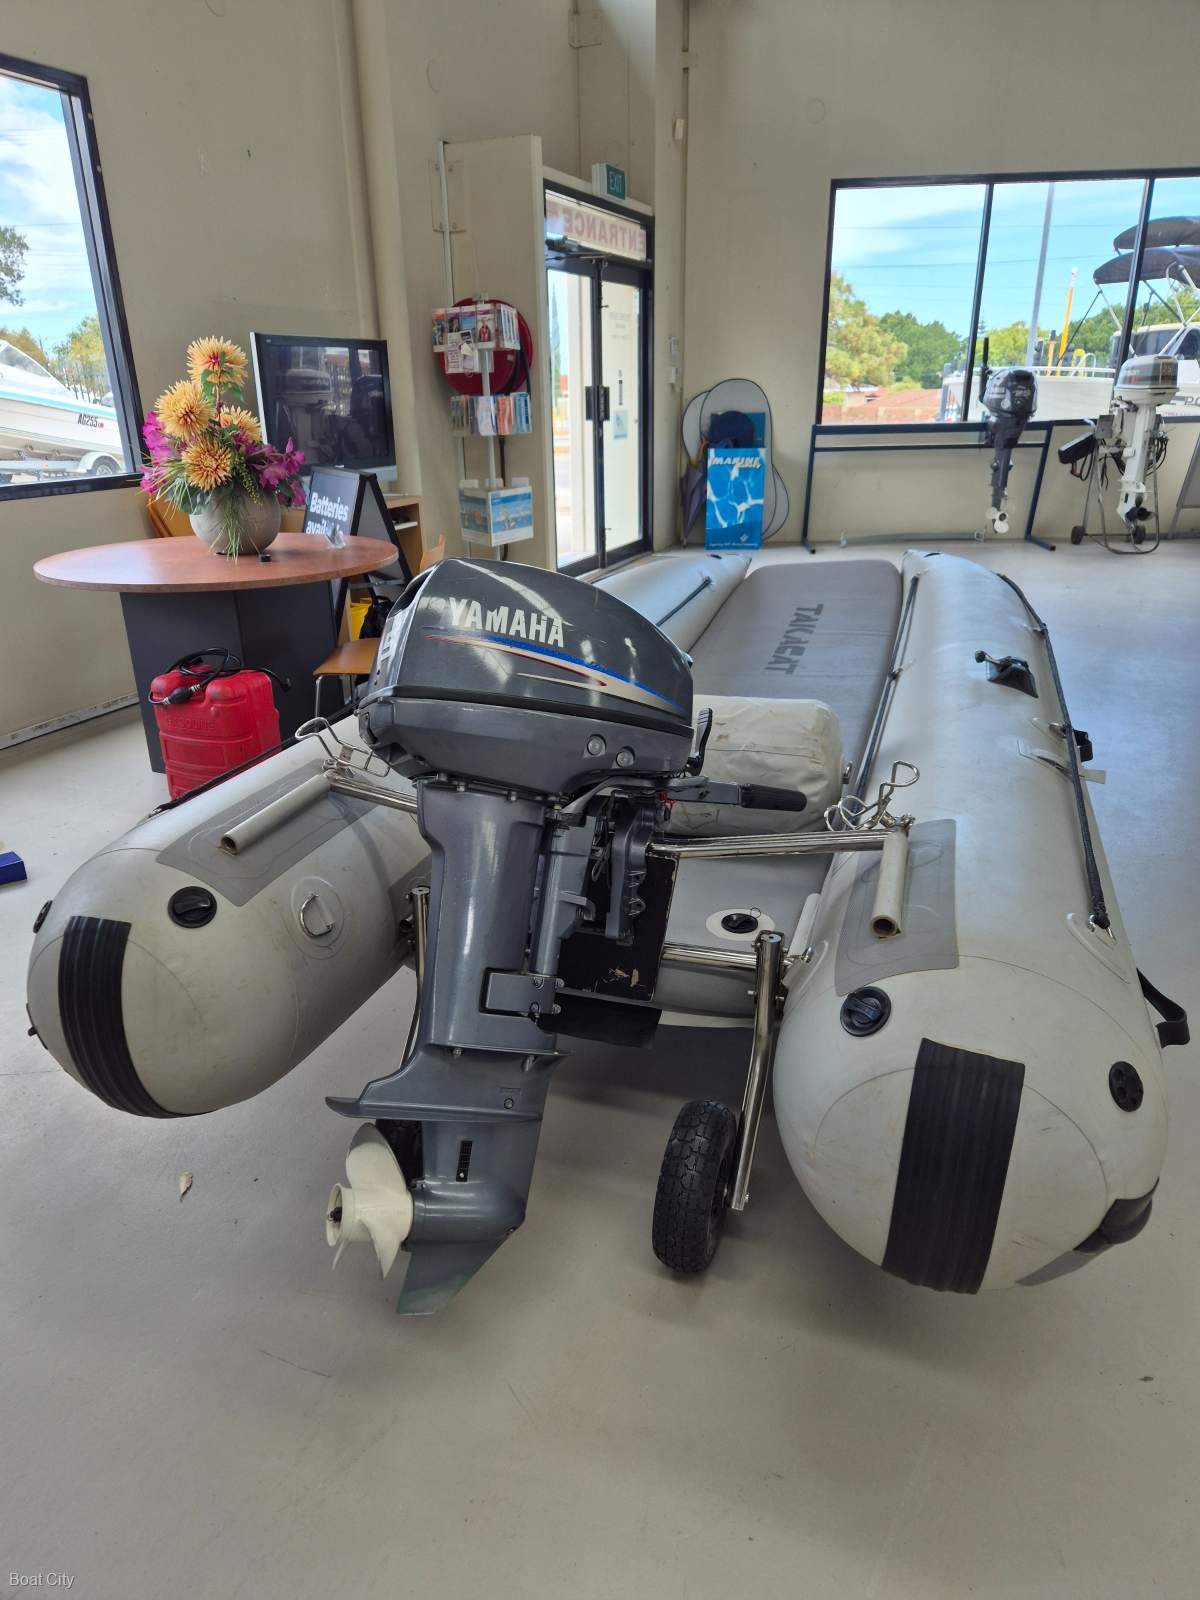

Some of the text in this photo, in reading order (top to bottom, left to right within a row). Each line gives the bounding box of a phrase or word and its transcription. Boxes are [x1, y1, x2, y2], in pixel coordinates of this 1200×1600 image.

[609, 171, 622, 194] EXIT
[310, 492, 349, 522] Batteries
[449, 597, 564, 648] YAMAHA
